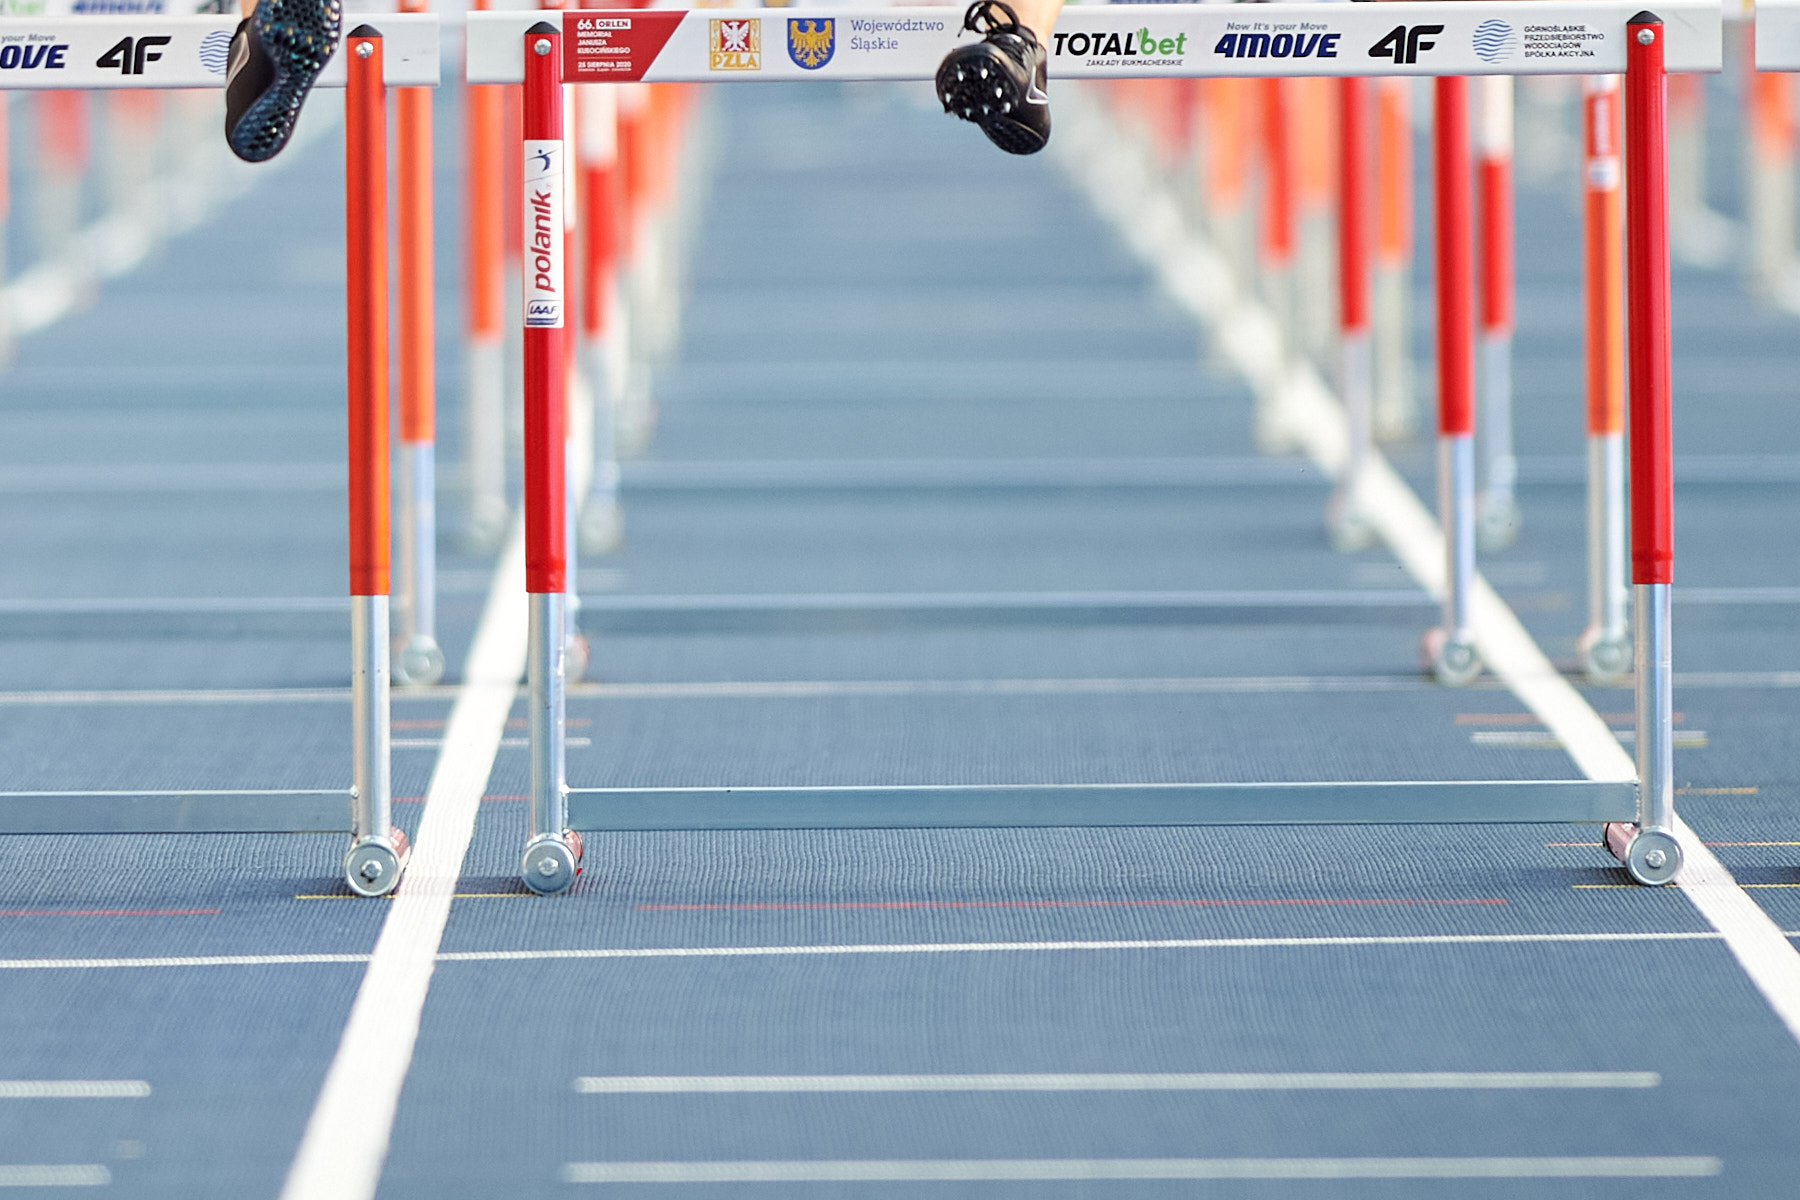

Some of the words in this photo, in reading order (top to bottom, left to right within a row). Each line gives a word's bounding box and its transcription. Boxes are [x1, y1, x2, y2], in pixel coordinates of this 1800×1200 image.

[577, 19, 595, 30] 66.
[598, 20, 629, 28] ORLEN
[850, 19, 944, 34] Województwo
[1226, 22, 1250, 30] Now
[1253, 22, 1269, 30] It's
[1273, 23, 1297, 32] your
[1300, 22, 1328, 30] Move
[1, 35, 25, 44] your
[28, 33, 56, 42] Move
[850, 36, 898, 53] Śląskie
[1053, 27, 1187, 56] TOTALbet
[1214, 33, 1341, 58] 4MOVE
[1368, 25, 1445, 64] 4F
[96, 36, 172, 75] 4F
[711, 53, 758, 68] PZLA
[530, 189, 556, 293] polanik
[530, 305, 557, 315] IAAF
